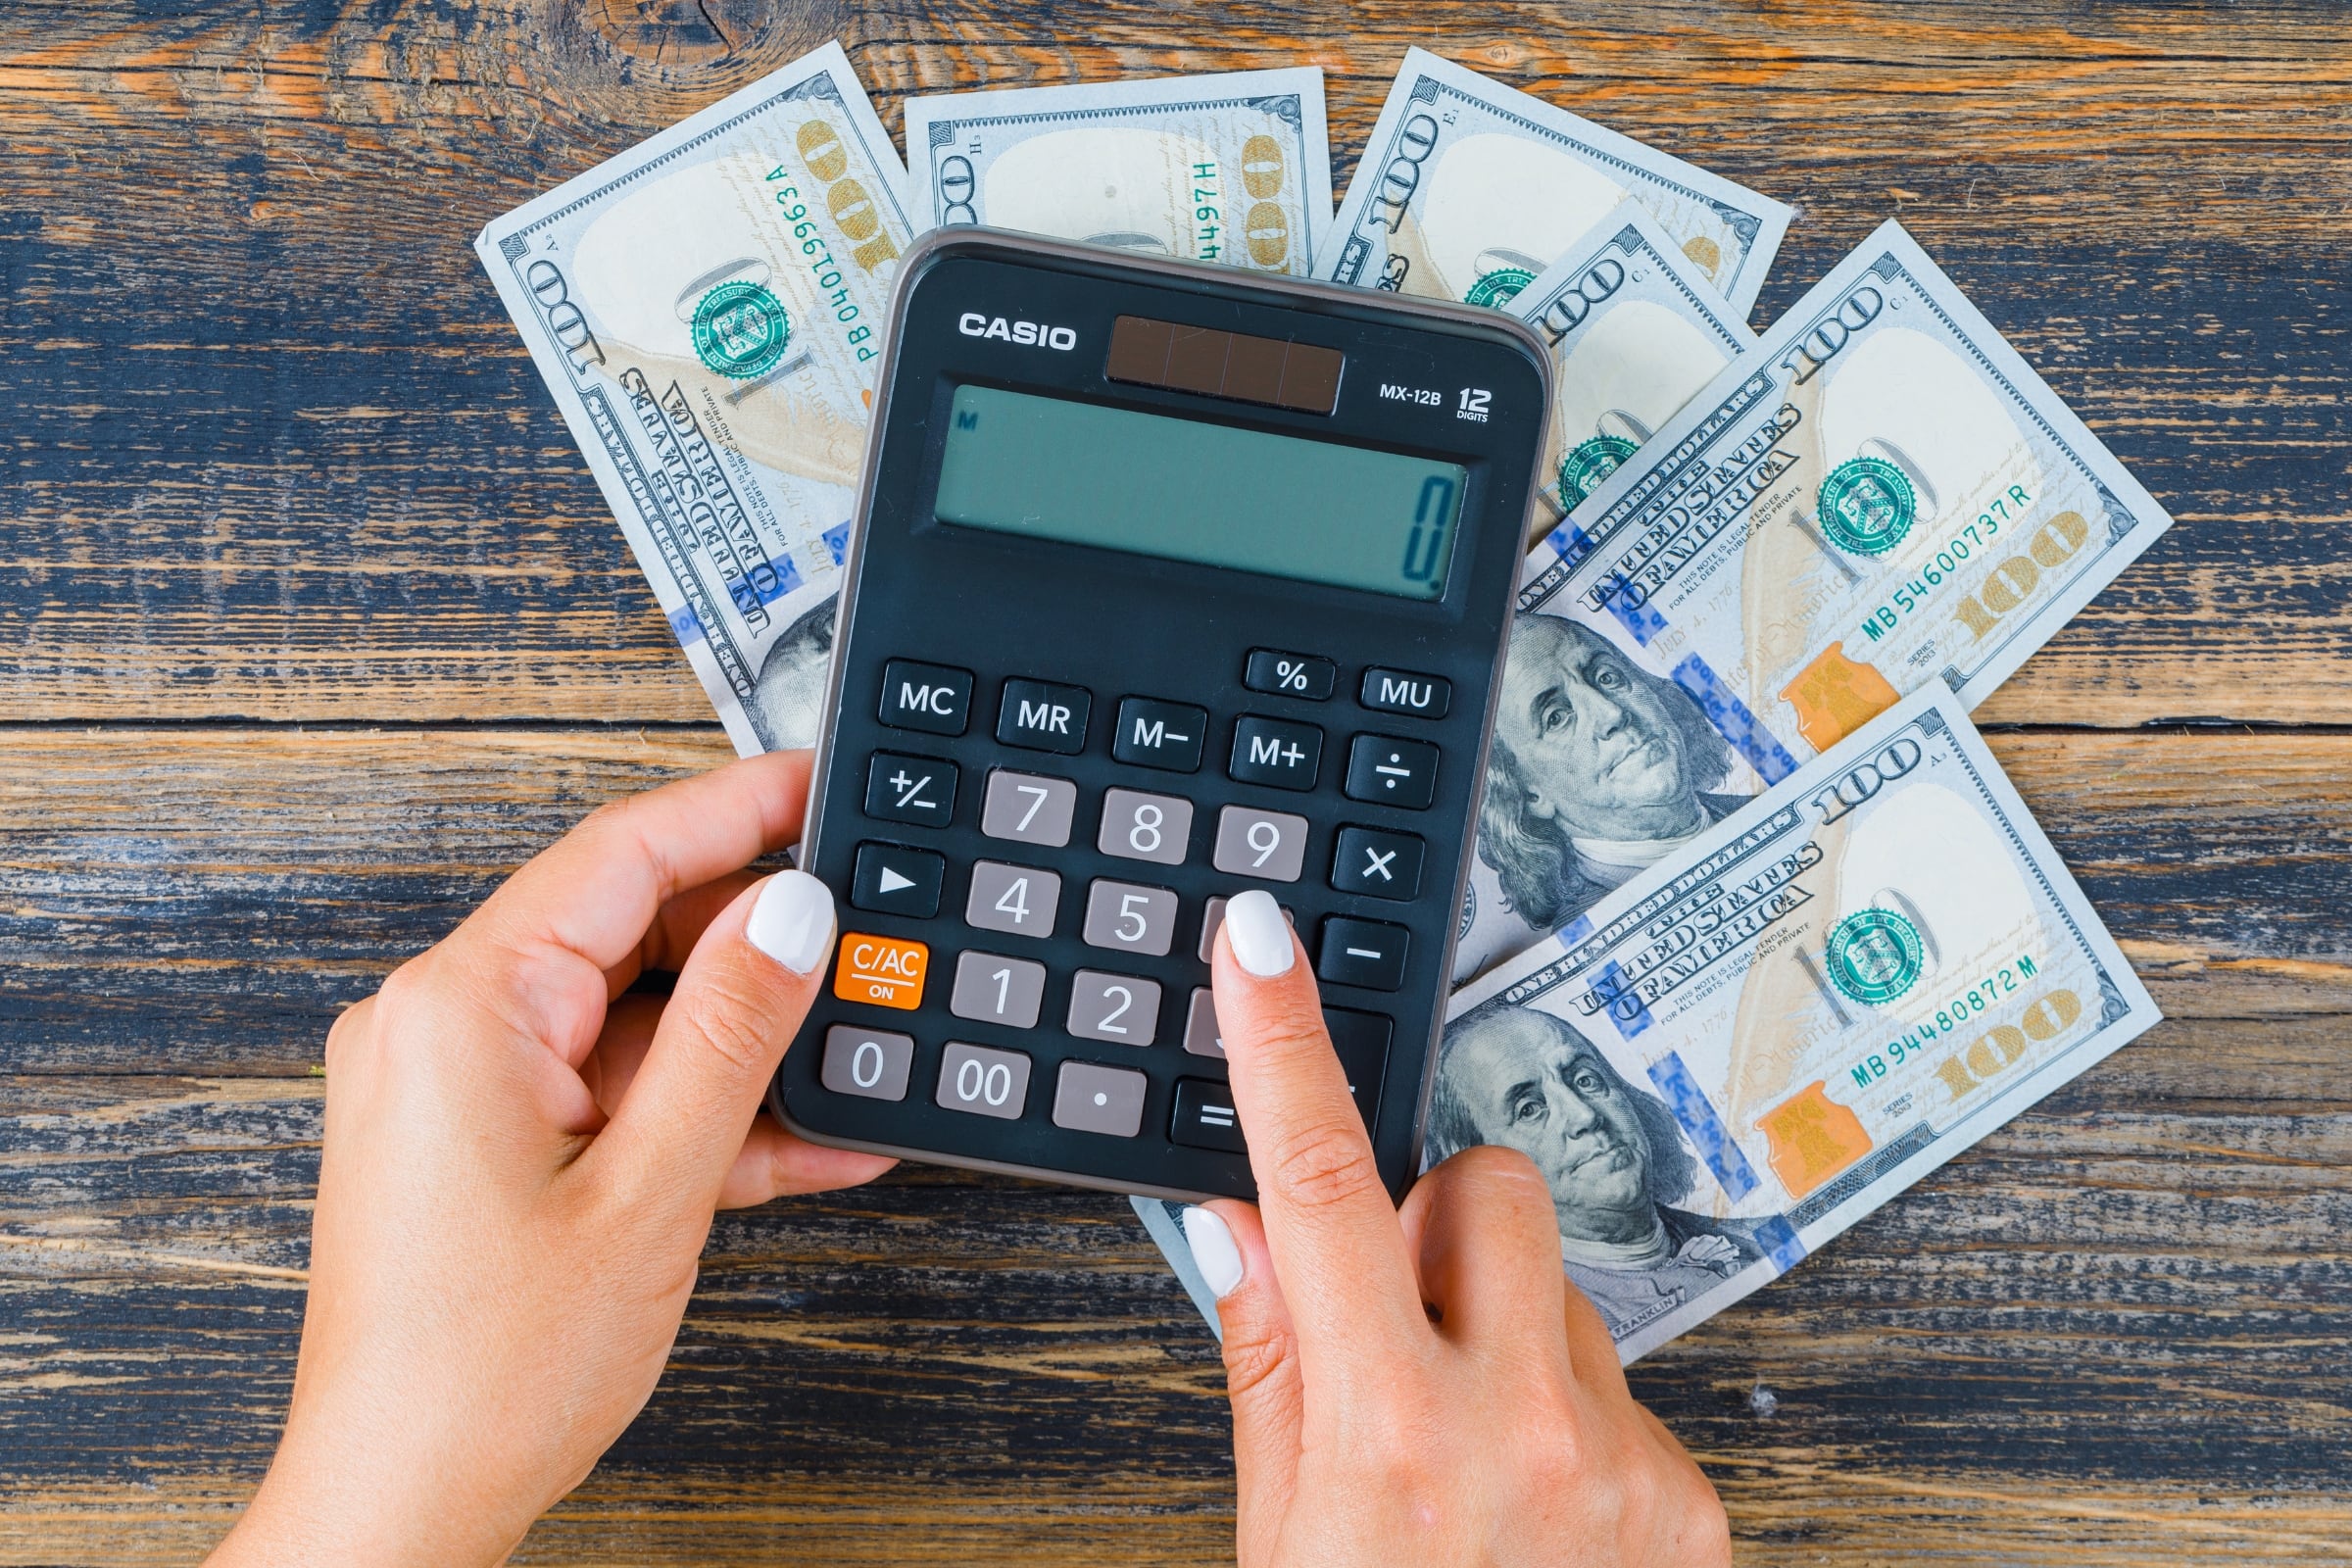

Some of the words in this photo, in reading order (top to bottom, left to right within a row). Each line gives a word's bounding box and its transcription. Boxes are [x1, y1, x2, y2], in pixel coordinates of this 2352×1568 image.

[761, 161, 790, 186] A
[1369, 115, 1439, 234] 100
[797, 122, 898, 272] 100
[777, 187, 858, 321] 04019963
[527, 260, 606, 374] 100
[959, 314, 1076, 351] CASIO
[1781, 287, 1883, 385] 100
[701, 386, 723, 421] PRIVATE
[1380, 384, 1442, 406] MX-12B
[1456, 411, 1489, 422] DIGITS
[1460, 388, 1492, 414] 12
[619, 368, 704, 504] STATES
[704, 410, 725, 446] TENDER
[720, 422, 734, 441] AND
[956, 409, 979, 432] M
[586, 397, 657, 516] DOLLARS
[662, 380, 758, 549] AMERICA
[723, 445, 741, 473] LEGAL
[730, 443, 752, 475] PUBLIC
[737, 474, 746, 484] IS
[652, 469, 701, 554] THE
[742, 485, 760, 510] NOTE
[750, 476, 768, 509] DEBTS,
[1517, 568, 1560, 608] ONE
[1552, 473, 1660, 573] HUNDRED
[1660, 378, 1767, 476] DOLLARS
[1578, 507, 1690, 612] UNITED
[1685, 403, 1801, 515] STATES
[1637, 461, 1710, 526] THE
[756, 511, 770, 531] THIS
[766, 510, 778, 526] ALL
[774, 528, 788, 547] FOR
[1620, 564, 1672, 615] OF
[1660, 450, 1800, 578] AMERICA
[1669, 594, 1686, 611] FOR
[1686, 582, 1701, 596] ALL
[1699, 557, 1728, 581] DEBTS,
[1727, 528, 1755, 556] PUBLIC
[1752, 512, 1774, 532] AND
[1771, 486, 1802, 514] PRIVATE
[1679, 571, 1697, 589] THIS
[1696, 552, 1718, 572] NOTE
[1716, 542, 1728, 554] IS
[1726, 522, 1751, 545] LEGAL
[1749, 494, 1781, 521] TENDER
[1862, 607, 1897, 642] MB
[1893, 500, 2009, 613] 54600737
[2008, 485, 2031, 507] R
[652, 520, 724, 646] HUNDRED
[690, 502, 770, 638] UNITED
[739, 538, 782, 596] OF
[1956, 512, 2087, 640] 100
[715, 642, 752, 697] ONE
[1907, 639, 1936, 666] SERIES
[1918, 649, 1936, 667] 2013
[900, 682, 955, 715] MC
[1277, 662, 1307, 690] %
[1380, 678, 1432, 708] MU
[1018, 701, 1070, 734] MR
[1250, 736, 1305, 767] M+
[1812, 739, 1922, 825] 100
[1016, 785, 1048, 831] 7
[1130, 805, 1163, 852] 8
[1248, 821, 1280, 867] 9
[996, 878, 1029, 923] 4
[1115, 895, 1149, 942] 5
[1506, 968, 1557, 1003] ONE
[1553, 889, 1674, 975] HUNDRED
[1675, 811, 1791, 894] DOLLARS
[1645, 883, 1725, 940] THE
[1570, 925, 1696, 1016] UNITED
[1693, 841, 1824, 937] STATES
[854, 944, 919, 977] C/AC
[1608, 978, 1668, 1021] OF
[1661, 885, 1814, 994] AMERICA
[1661, 1011, 1678, 1026] FOR
[1677, 997, 1697, 1014] ALL
[1695, 980, 1726, 1002] DEBTS,
[1726, 956, 1758, 981] PUBLIC
[1759, 945, 1776, 960] AND
[1777, 922, 1809, 947] PRIVATE
[1673, 990, 1693, 1005] THIS
[1693, 974, 1717, 993] NOTE
[1716, 966, 1729, 978] IS
[1728, 951, 1754, 970] LEGAL
[1755, 927, 1788, 952] TENDER
[869, 985, 894, 1000] ON
[993, 969, 1010, 1014] 1
[1098, 986, 1132, 1034] 2
[1851, 1055, 1886, 1088] MB
[1888, 970, 2017, 1064] 94480872
[2017, 956, 2037, 979] M
[1938, 991, 2081, 1099] 100
[853, 1042, 884, 1088] 0
[957, 1059, 1011, 1105] 00
[1883, 1094, 1913, 1115] SERIES
[1892, 1102, 1912, 1118] 2013
[1614, 1295, 1673, 1340] FRANKLIN
